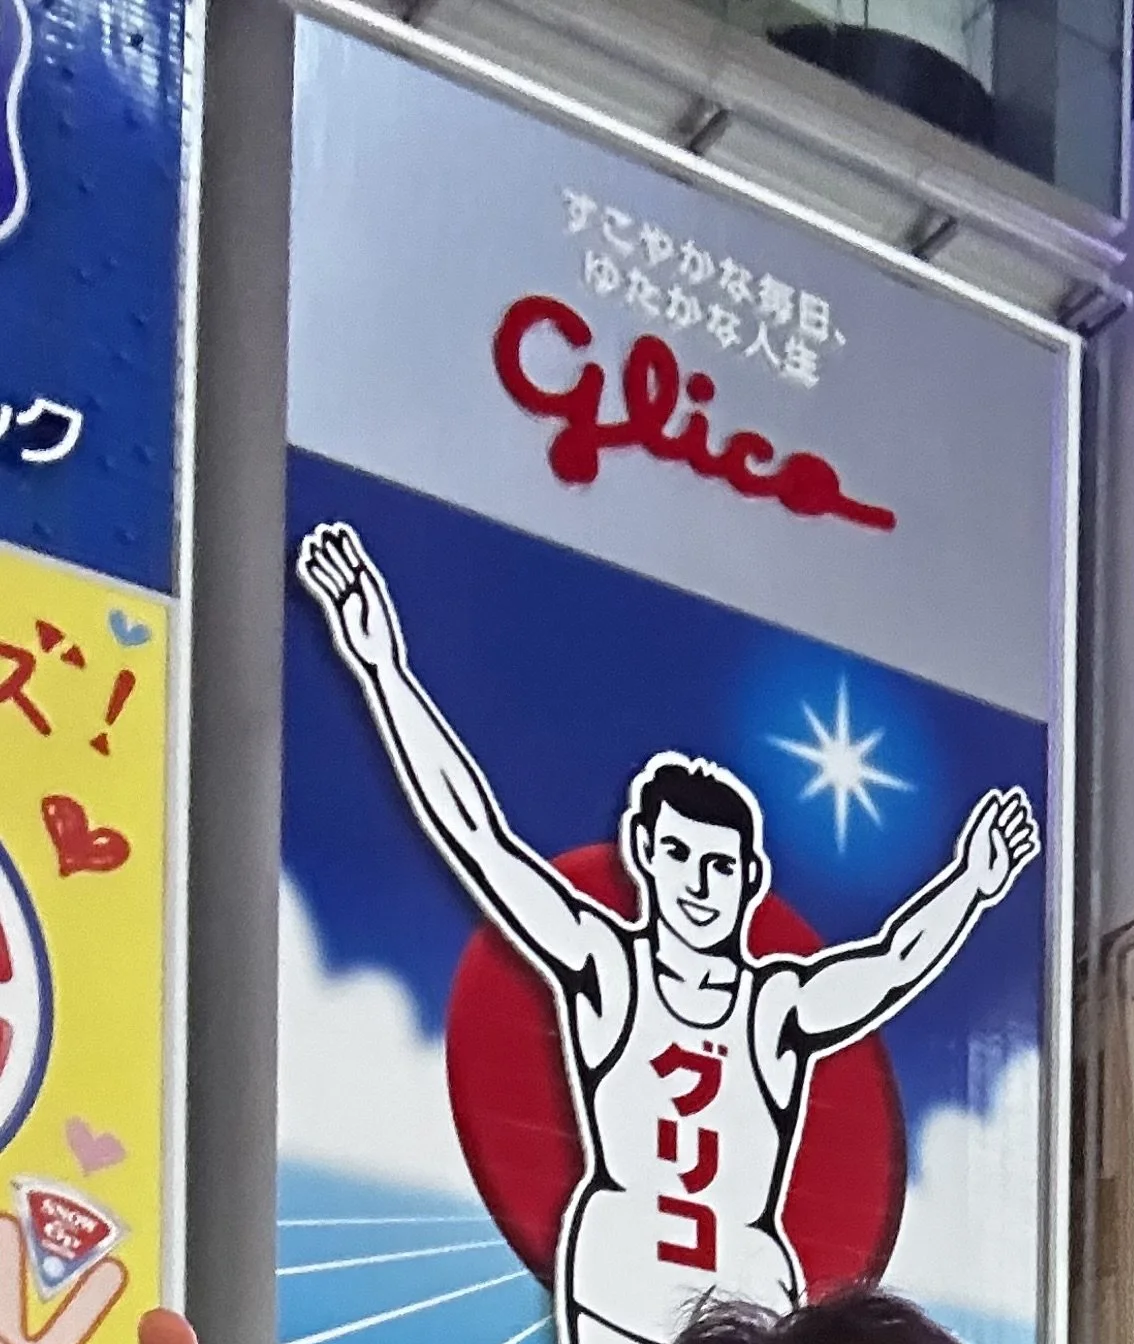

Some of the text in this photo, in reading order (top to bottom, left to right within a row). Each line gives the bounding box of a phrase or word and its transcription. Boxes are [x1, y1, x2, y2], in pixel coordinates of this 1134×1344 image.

[492, 295, 897, 533] Glico
[583, 249, 820, 389] ゆたかな人生
[650, 1040, 729, 1272] グリコ
